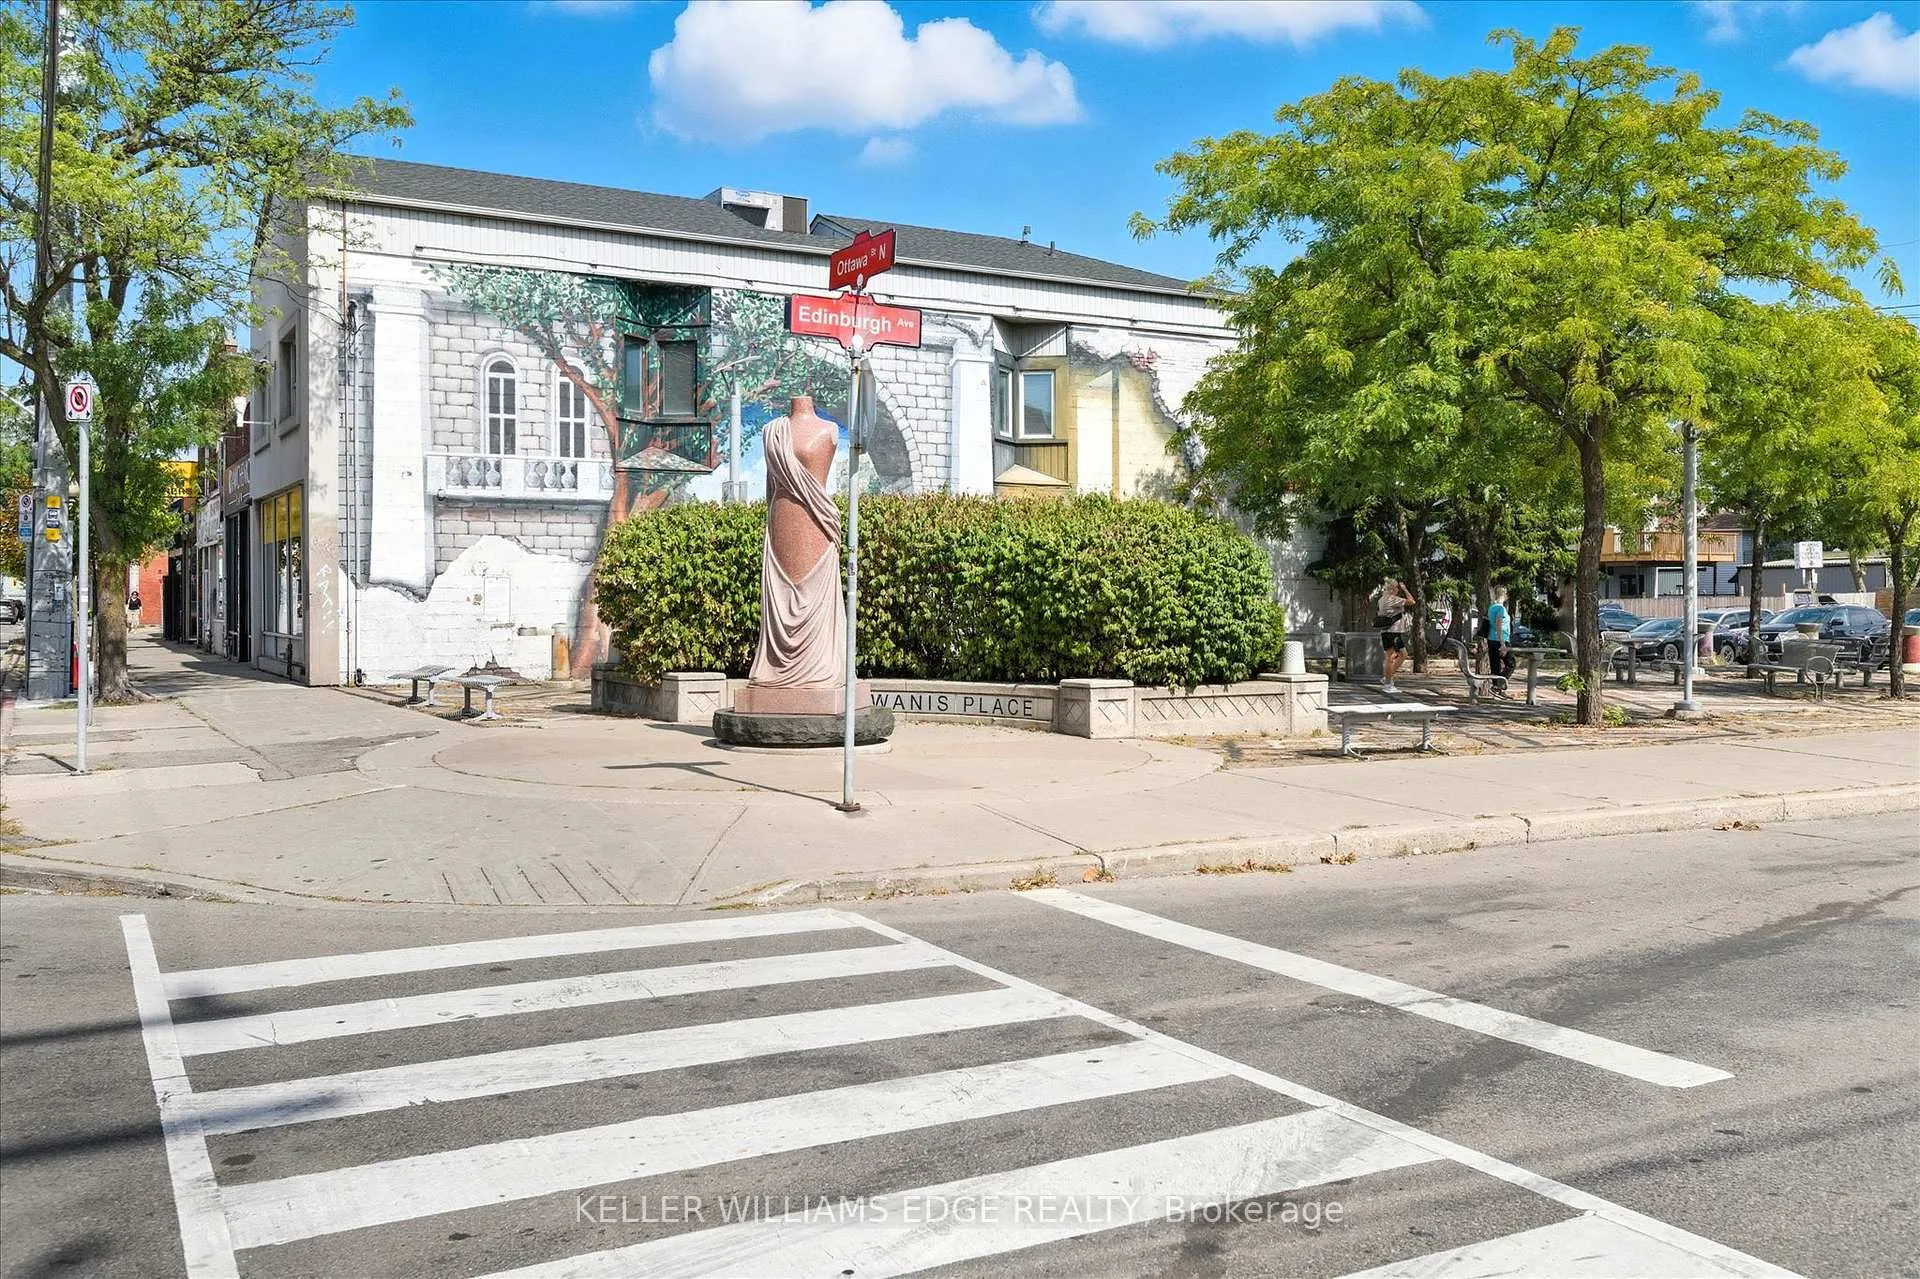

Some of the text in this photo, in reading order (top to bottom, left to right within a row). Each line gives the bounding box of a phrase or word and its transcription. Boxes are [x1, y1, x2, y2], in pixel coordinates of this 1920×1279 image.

[837, 256, 867, 276] Ottawa
[879, 244, 886, 260] N
[799, 306, 914, 333] Edinburgh Ave
[963, 696, 1033, 716] PLACE
